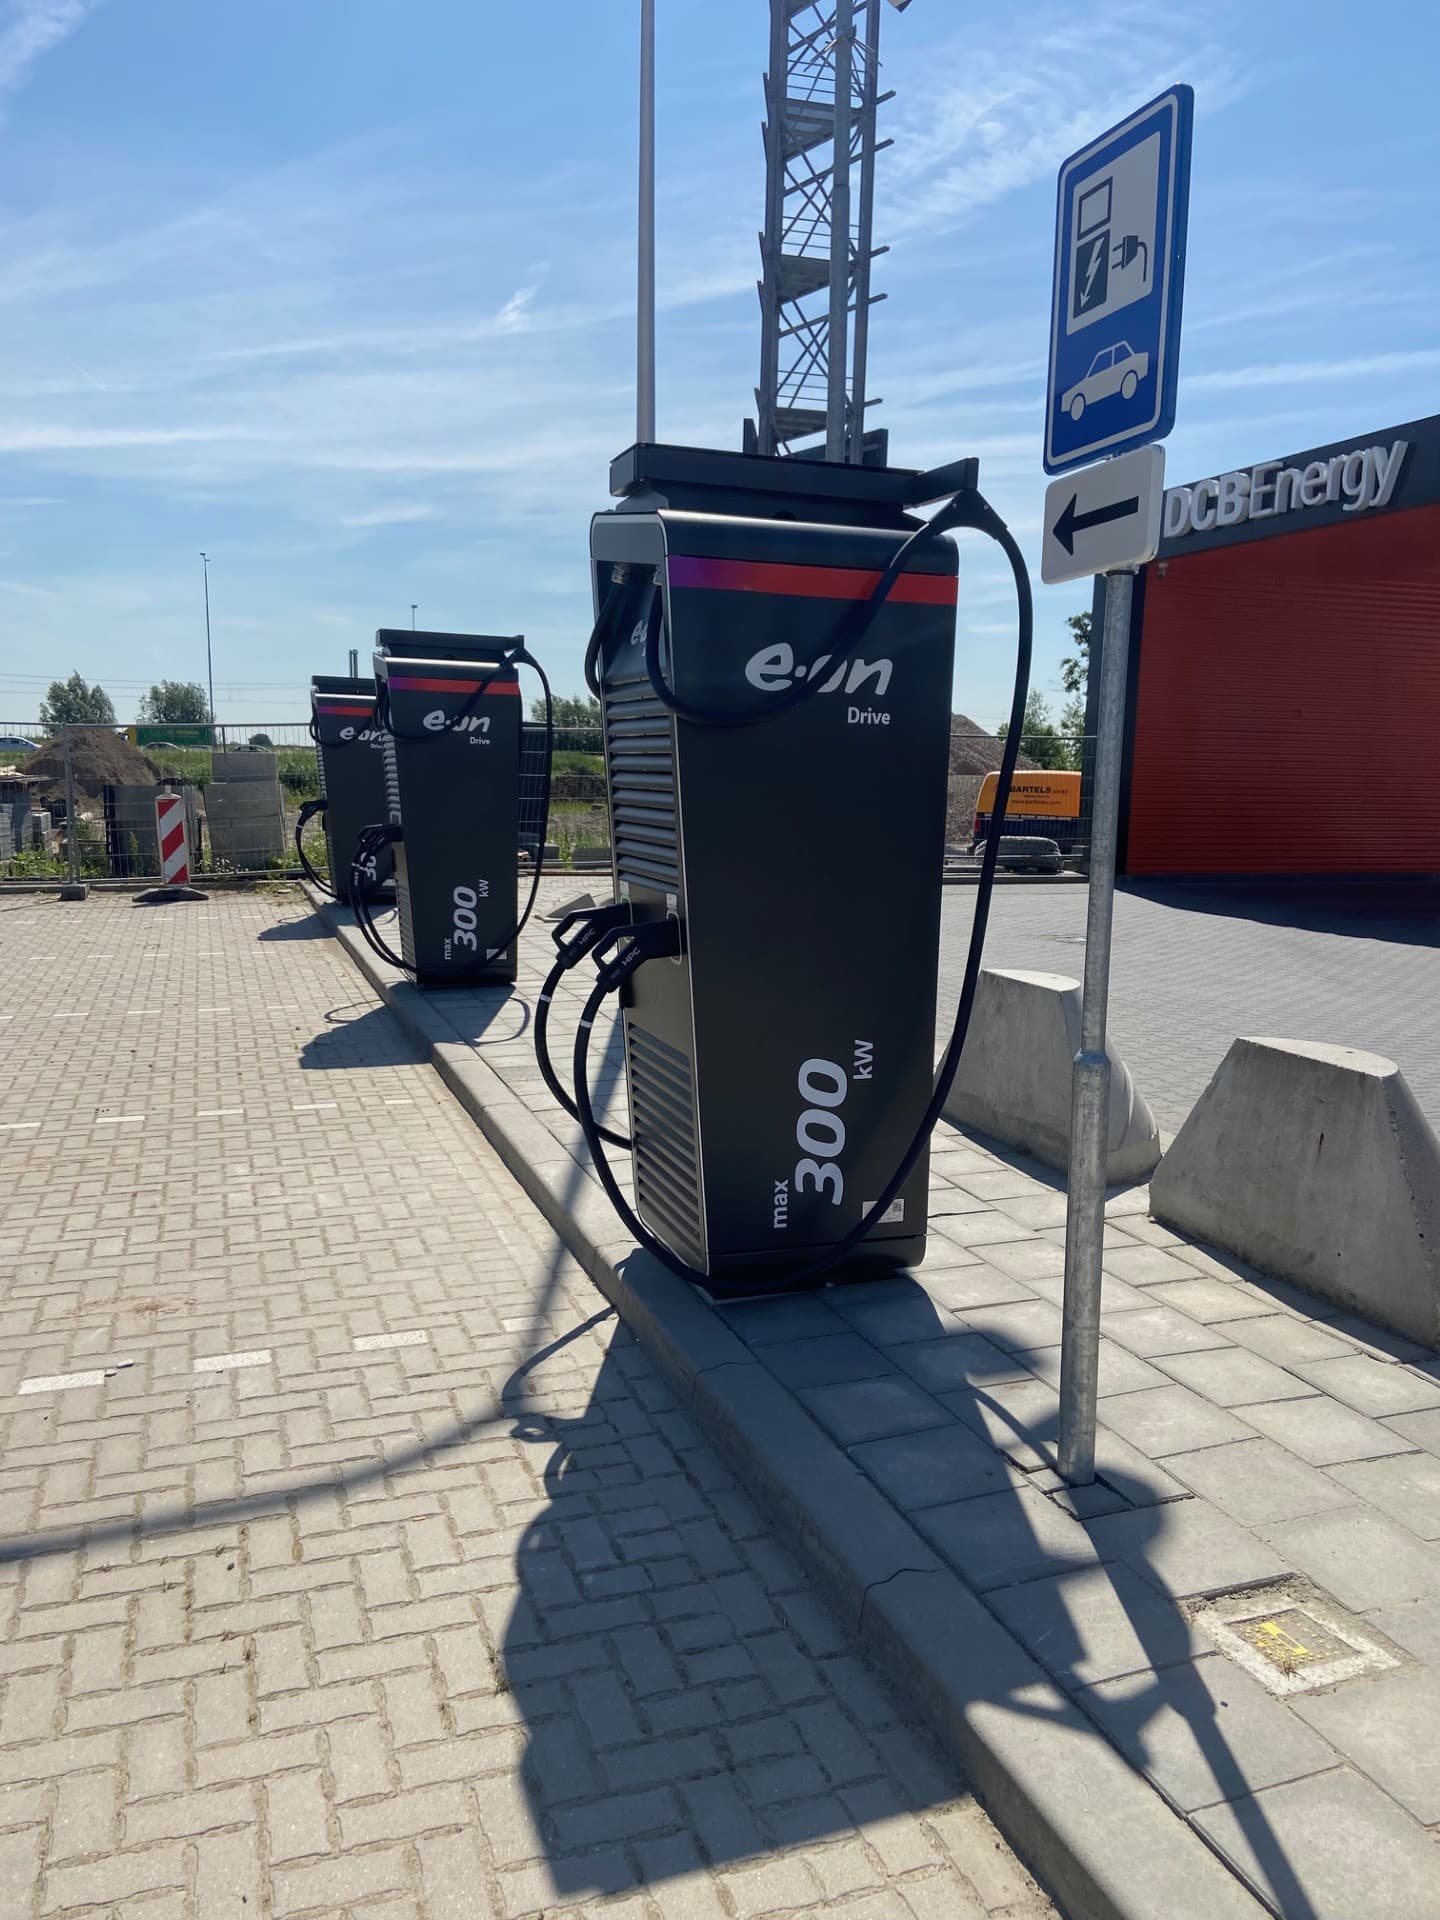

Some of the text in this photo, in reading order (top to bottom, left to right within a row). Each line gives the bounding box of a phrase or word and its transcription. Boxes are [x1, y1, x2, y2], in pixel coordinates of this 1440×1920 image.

[1163, 440, 1409, 538] DCBEnergy
[847, 706, 891, 725] Drive
[469, 736, 491, 745] Drive
[444, 879, 489, 960] max 300 kW
[578, 928, 597, 945] HPC
[621, 947, 641, 966] HPC
[773, 1039, 874, 1229] max 300 kW
